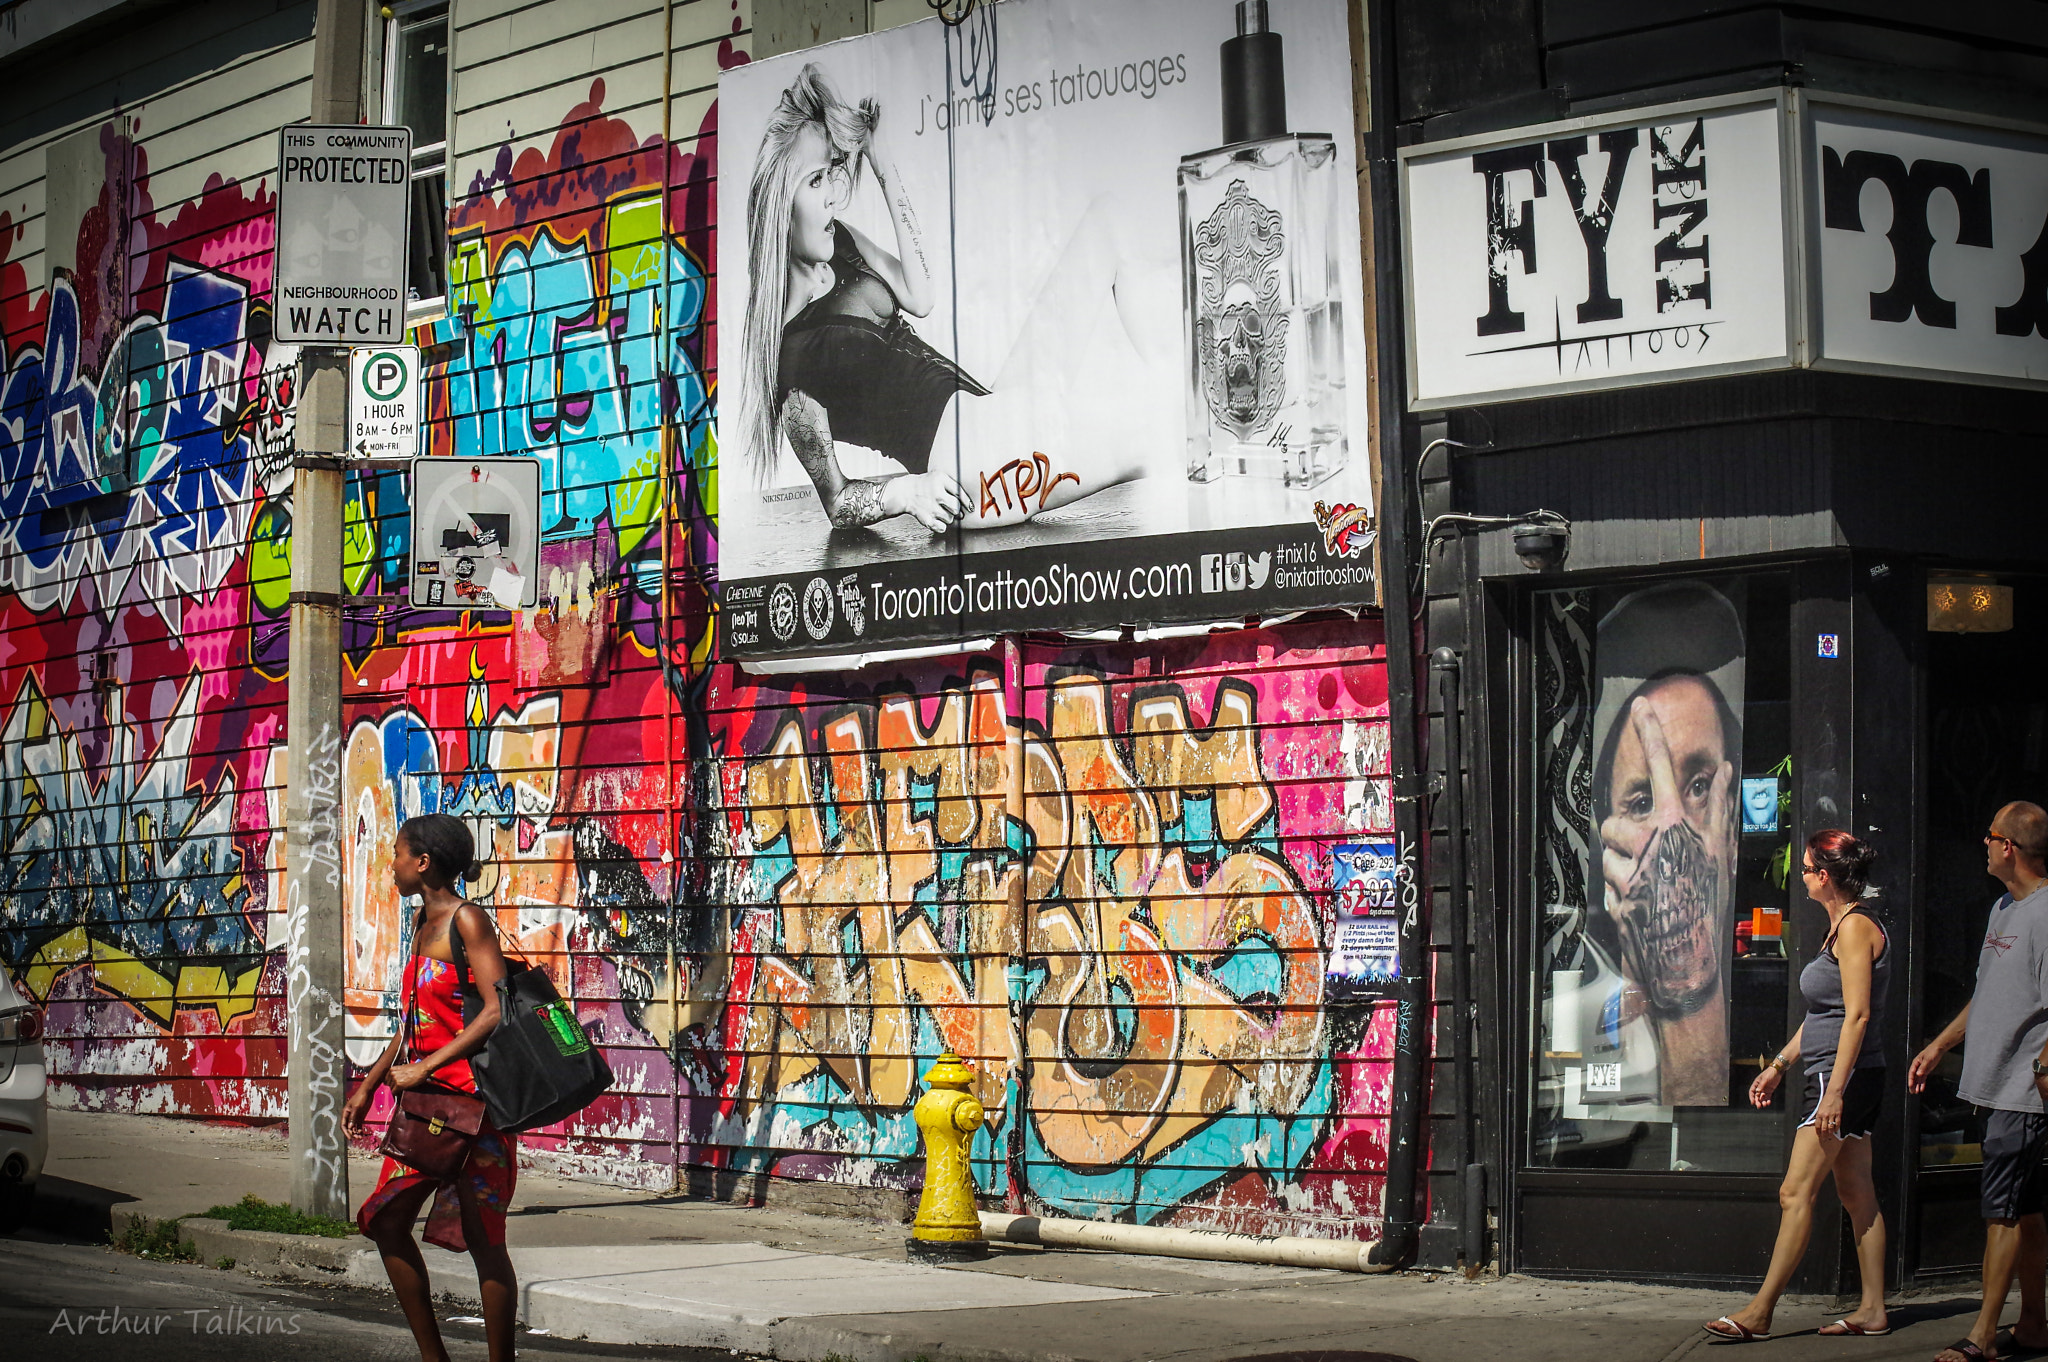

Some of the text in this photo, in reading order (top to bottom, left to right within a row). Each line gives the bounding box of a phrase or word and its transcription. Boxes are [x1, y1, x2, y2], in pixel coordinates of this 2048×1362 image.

[1004, 82, 1042, 117] ses
[1050, 53, 1187, 107] tatouages
[287, 135, 405, 149] THIS COMMUNITY
[284, 156, 405, 184] PROTECTED
[1473, 127, 1639, 337] FY
[284, 286, 398, 300] NEIGHBOURHOOD
[289, 307, 392, 335] WATCH
[363, 404, 405, 419] 1 HOUR
[370, 442, 399, 451] MON-FRI
[1276, 542, 1317, 565] #nix16
[1274, 563, 1374, 589] @nixtattooshow
[871, 563, 1193, 621] TorontoTattooShow.com
[1354, 856, 1376, 872] Cage
[1379, 857, 1394, 869] 292
